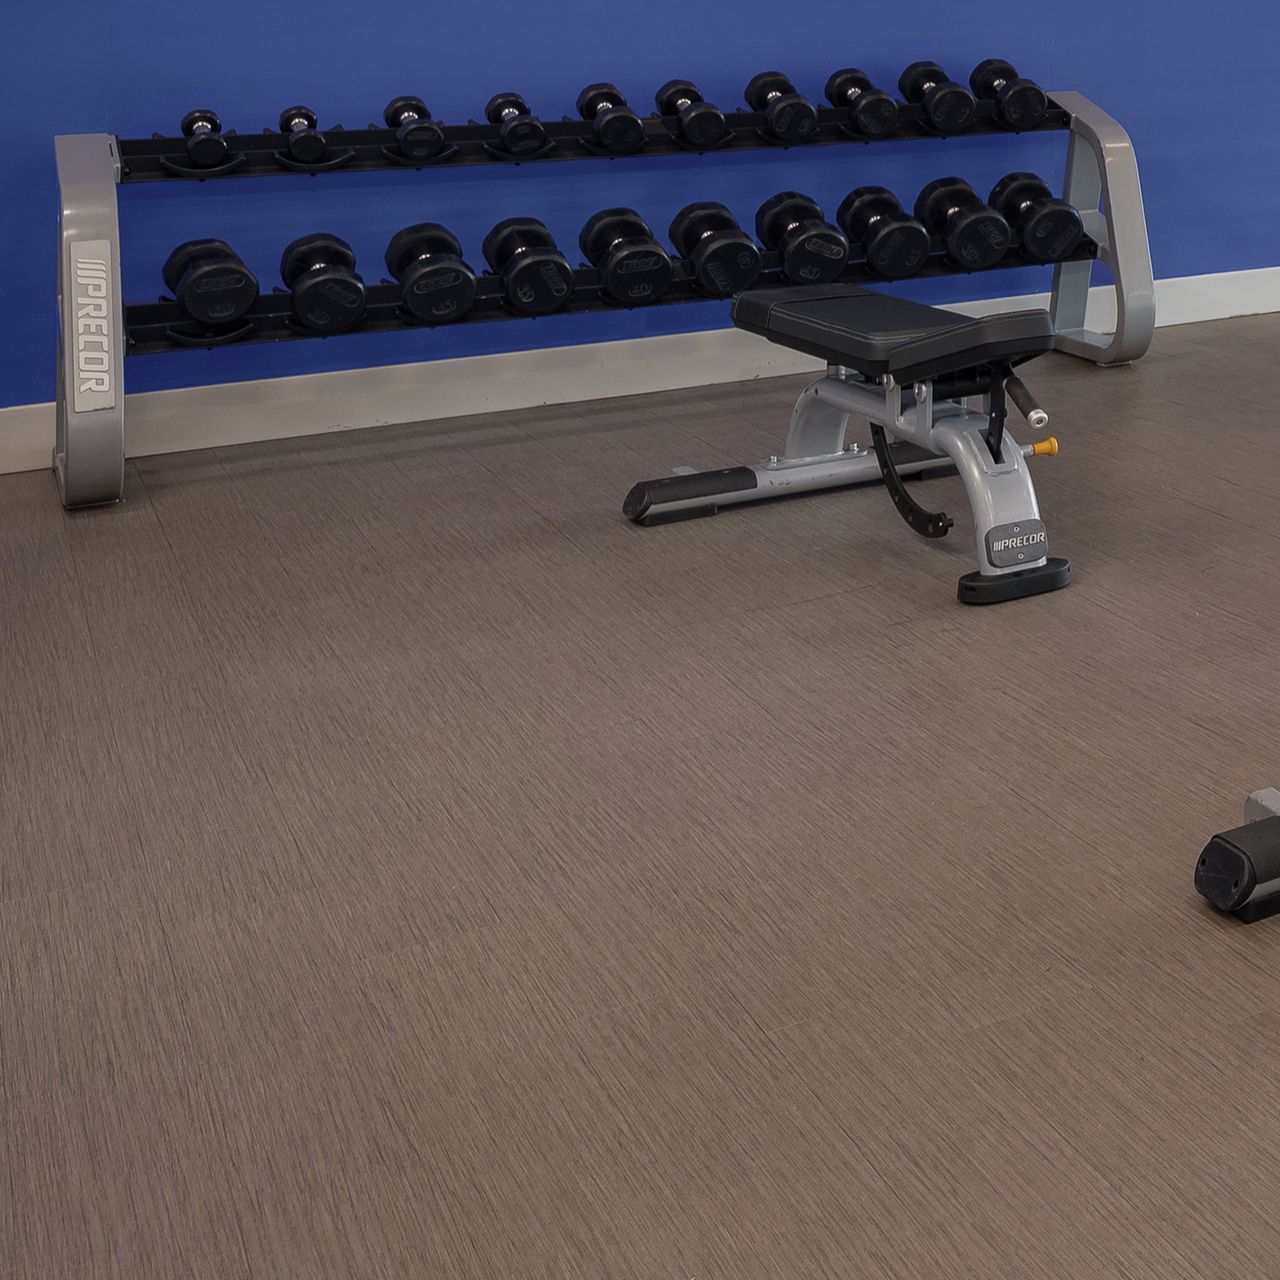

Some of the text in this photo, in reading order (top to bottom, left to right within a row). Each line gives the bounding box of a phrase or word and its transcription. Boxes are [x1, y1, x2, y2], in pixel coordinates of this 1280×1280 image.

[631, 283, 651, 295] 40
[77, 276, 111, 393] PRECOR
[1001, 532, 1045, 551] PRECOR
